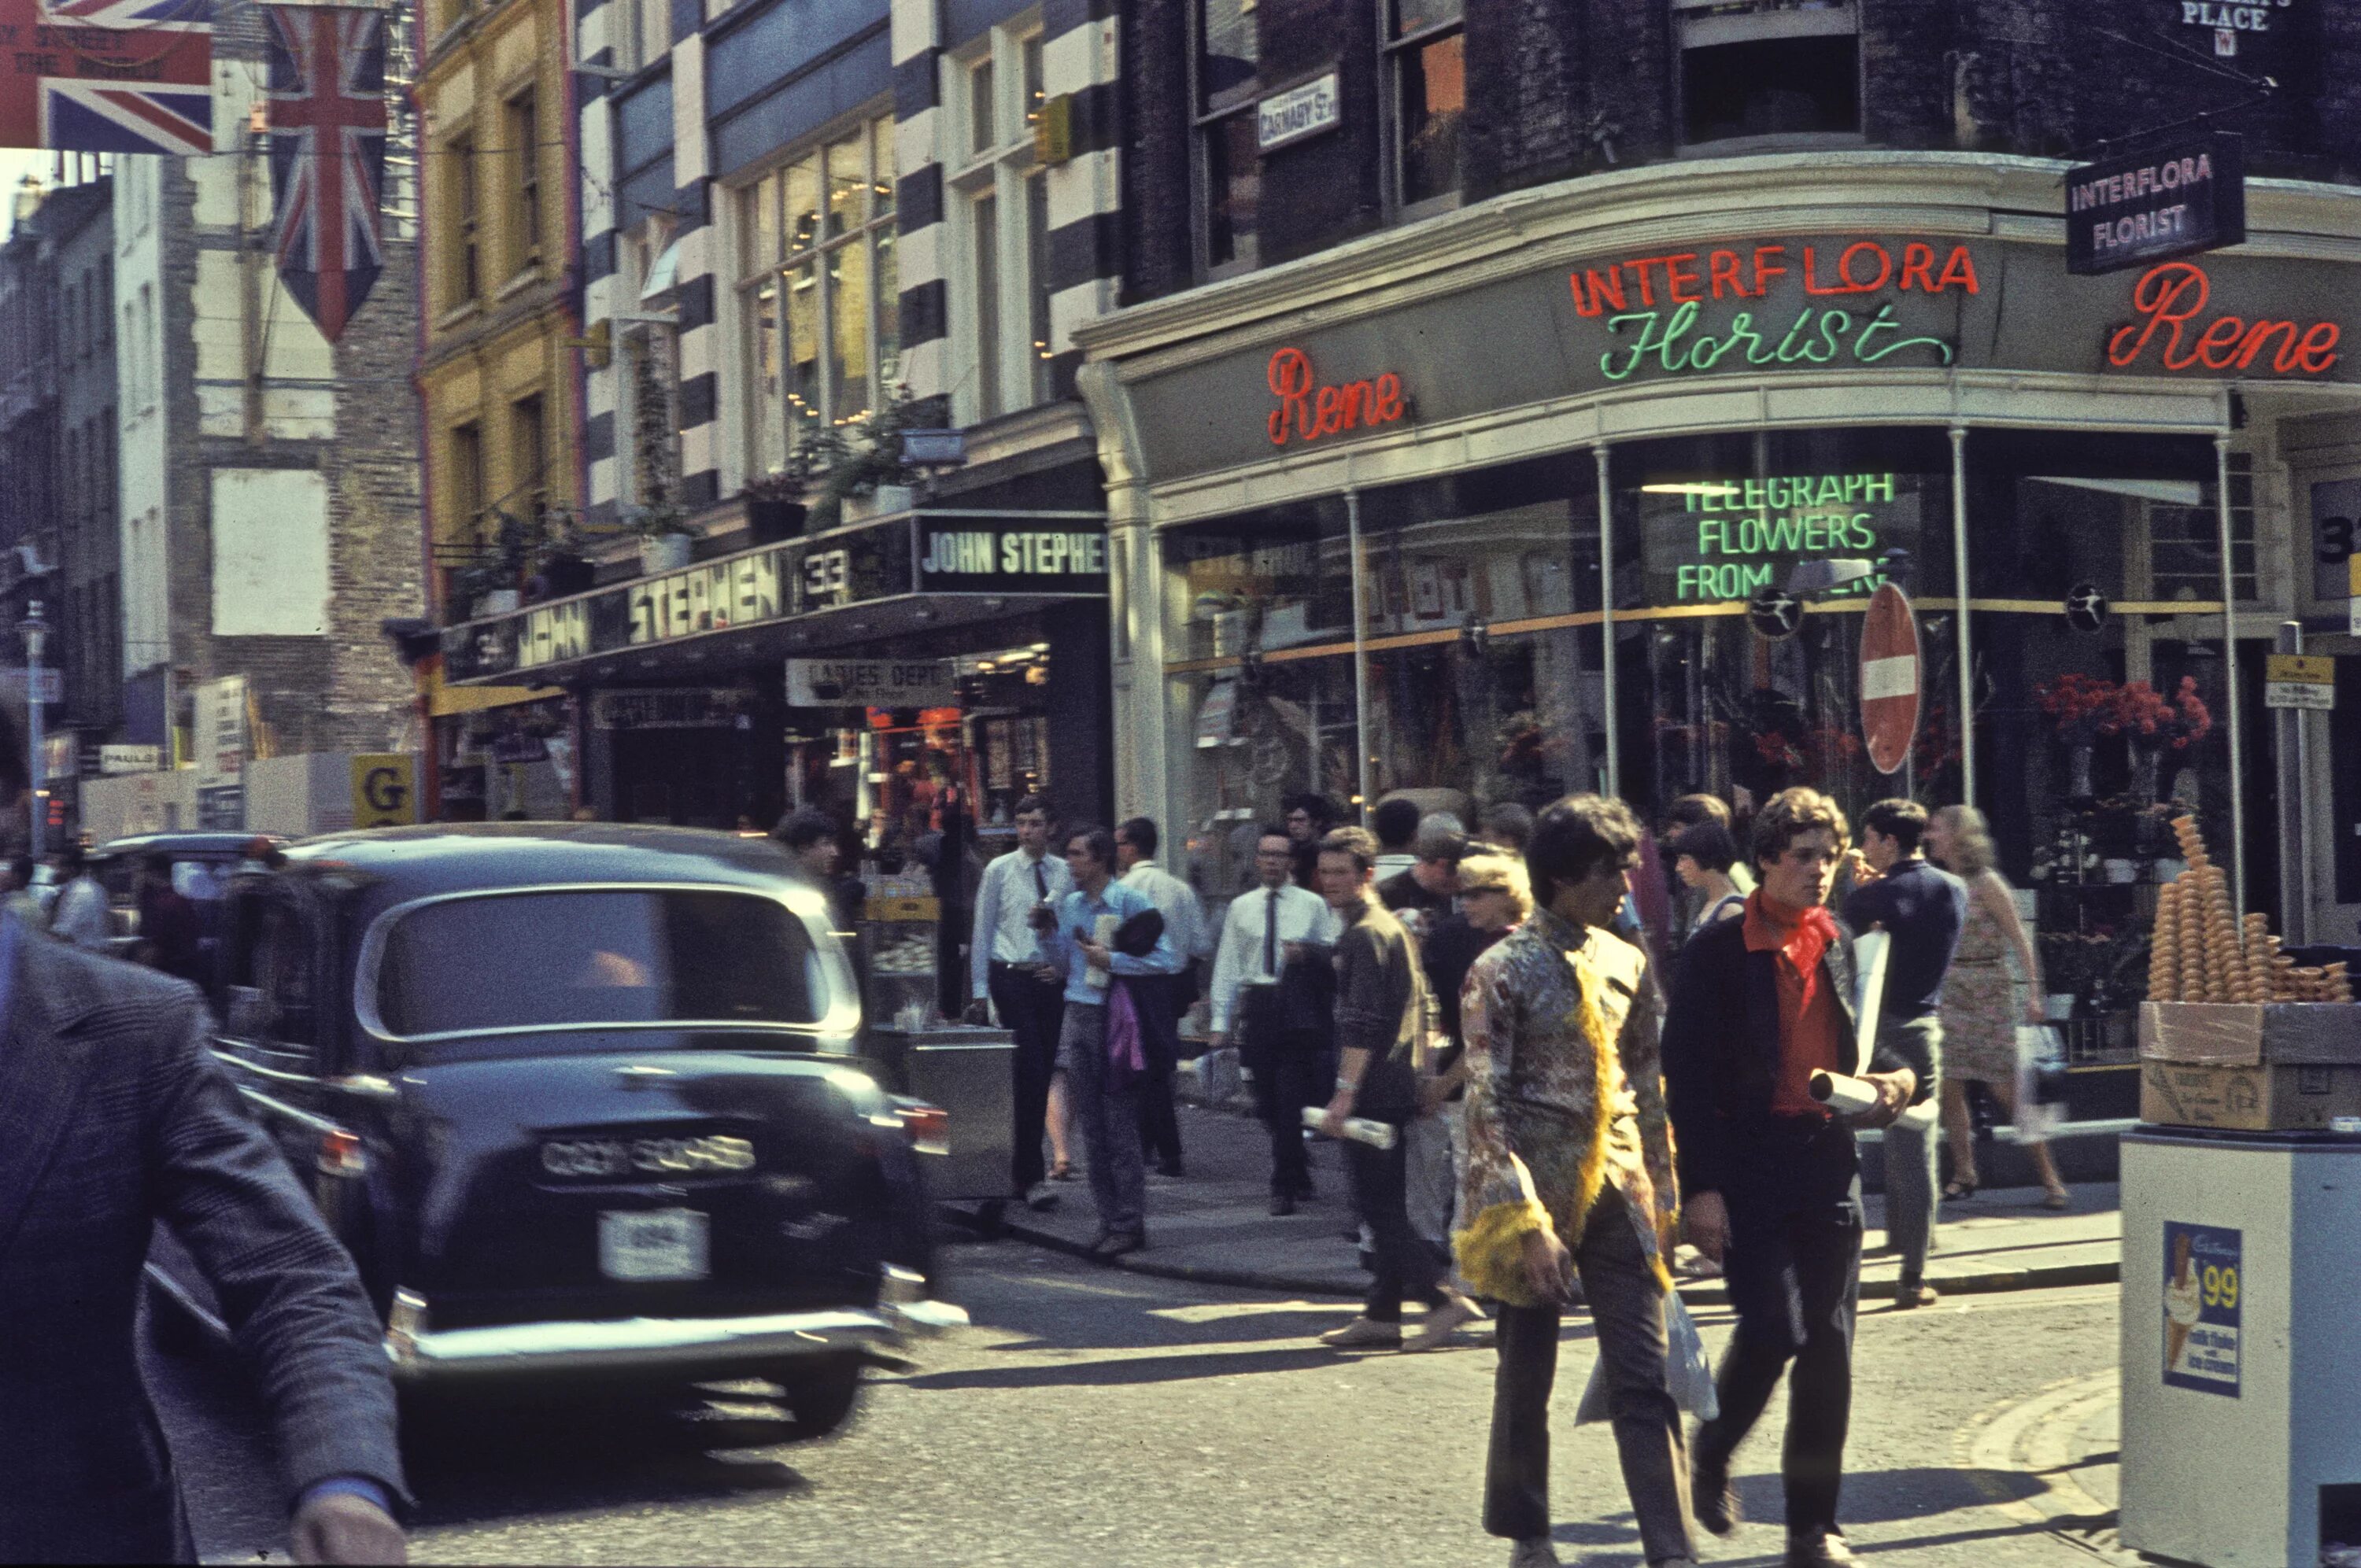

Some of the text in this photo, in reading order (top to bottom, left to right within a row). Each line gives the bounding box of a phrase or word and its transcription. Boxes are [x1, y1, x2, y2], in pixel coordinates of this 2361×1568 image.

[2182, 2, 2270, 31] PLACE
[1260, 100, 1313, 140] CARNABY
[2072, 153, 2213, 212] INTERFLORA
[2093, 205, 2187, 249] FLORIST
[1570, 242, 1979, 315] INTERFLORA
[2108, 262, 2341, 372] Rene
[1601, 301, 1953, 379] Florist
[1268, 347, 1404, 445] Rene
[1686, 473, 1894, 512] TELEGRAPH
[922, 533, 1108, 574] JOHN STEPHE
[1699, 513, 1876, 554] FLOWERS
[1677, 562, 1773, 599] FROM
[517, 600, 590, 668] JOHN
[630, 549, 782, 647] STEPHEN
[804, 549, 848, 596] 33
